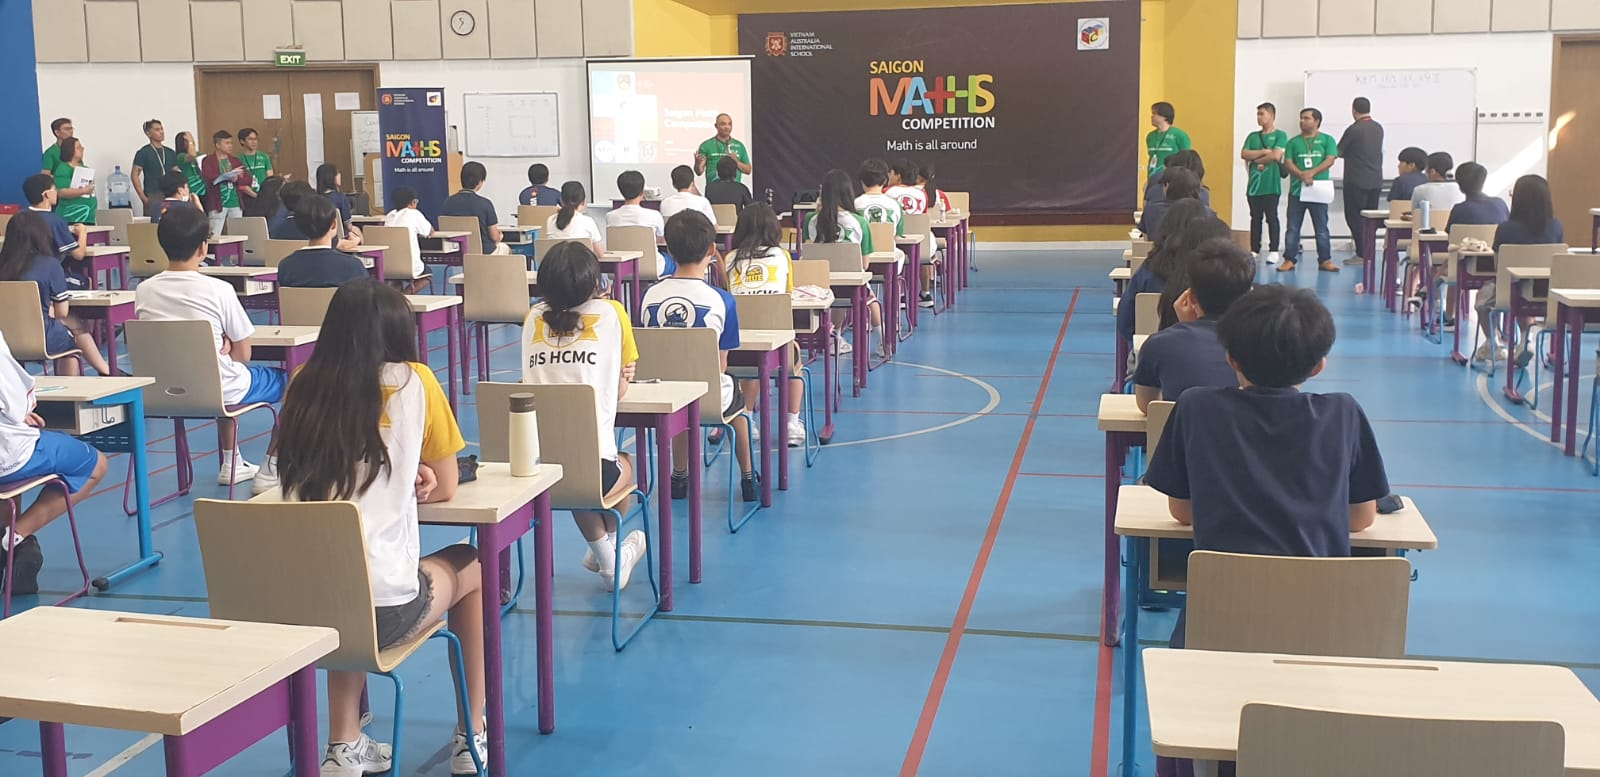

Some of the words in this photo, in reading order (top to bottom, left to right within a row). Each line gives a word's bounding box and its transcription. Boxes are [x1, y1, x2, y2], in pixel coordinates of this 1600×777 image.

[280, 55, 301, 64] EXIT
[870, 60, 924, 74] SAIGON
[902, 116, 996, 130] COMPETITION
[887, 140, 913, 151] Math
[915, 140, 924, 150] is
[925, 139, 938, 150] all
[940, 139, 978, 150] around
[529, 351, 546, 369] BIS
[550, 350, 597, 365] HCMC
